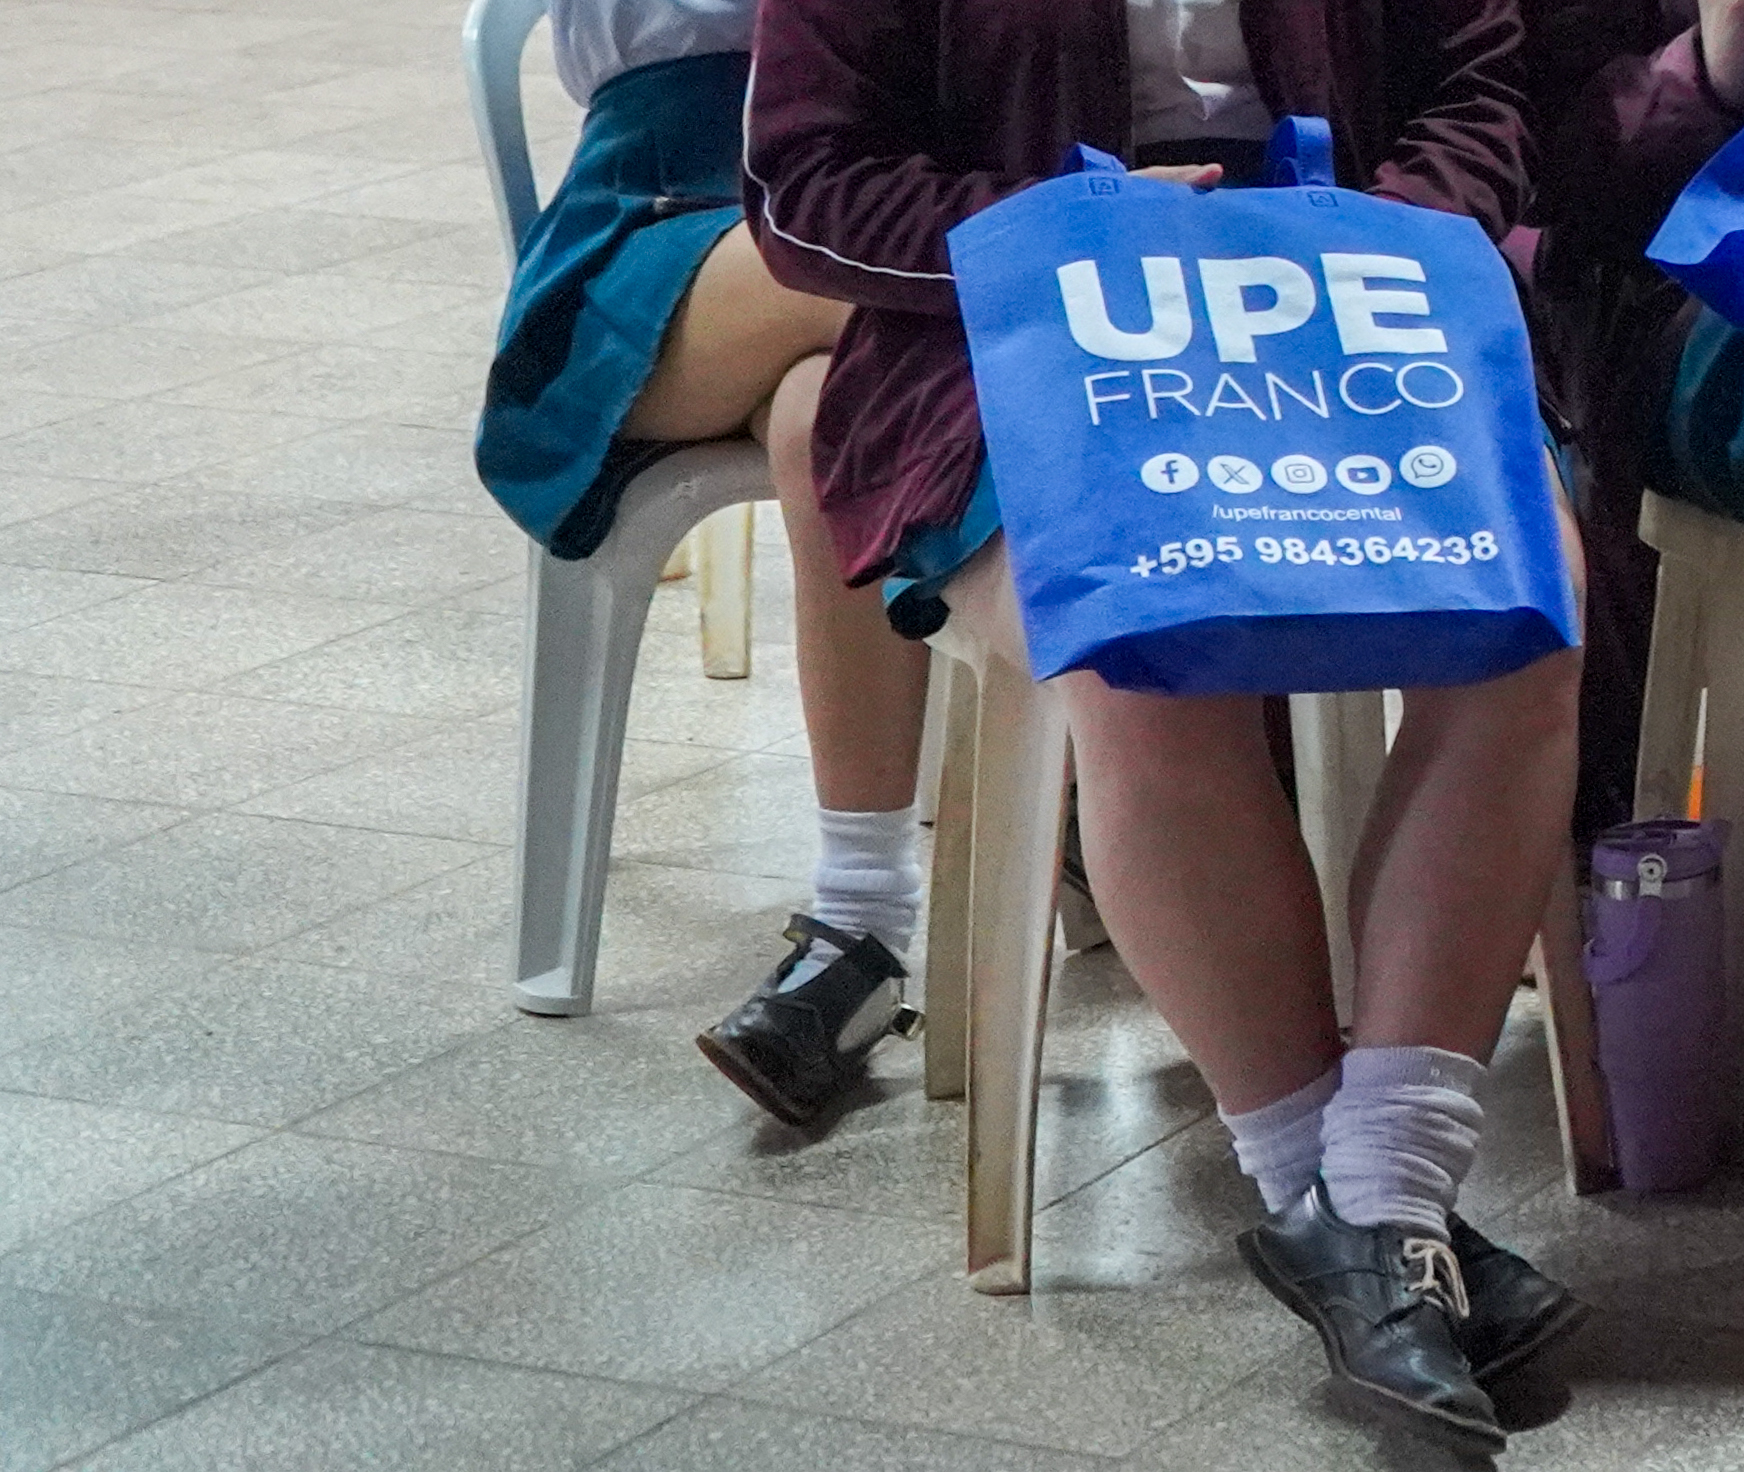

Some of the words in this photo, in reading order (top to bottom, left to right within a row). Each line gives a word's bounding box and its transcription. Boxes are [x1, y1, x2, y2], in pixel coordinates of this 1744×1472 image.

[1056, 252, 1448, 363] UPE
[1084, 361, 1464, 426] FRANCO
[1212, 504, 1402, 522] /upefrancocental
[1130, 536, 1243, 578] +595
[1255, 531, 1499, 565] 984364238
